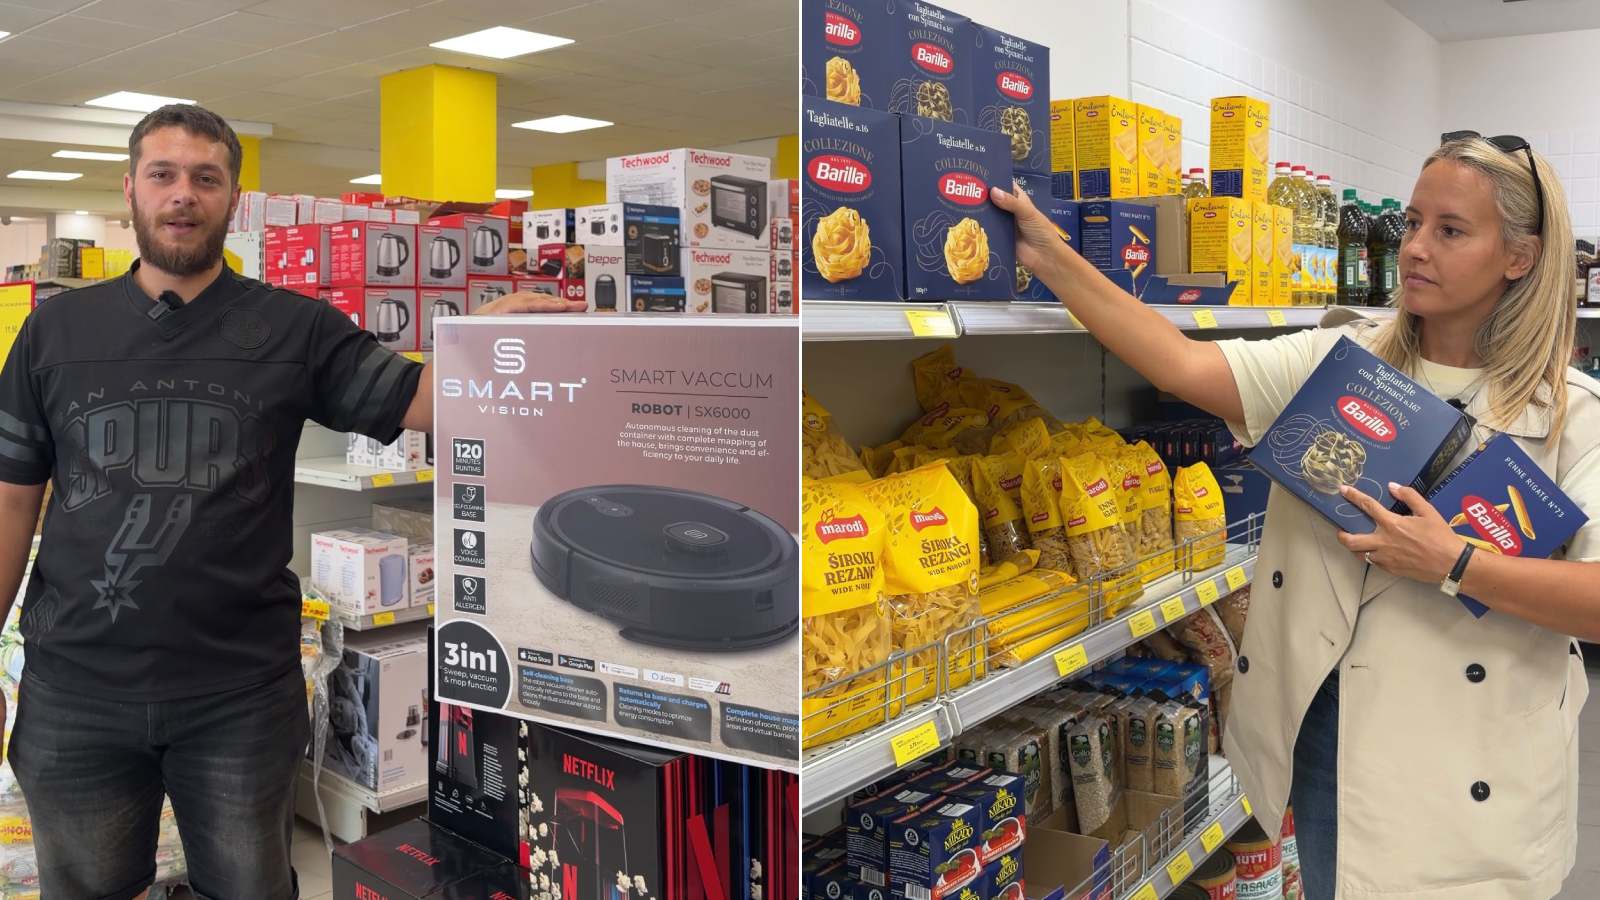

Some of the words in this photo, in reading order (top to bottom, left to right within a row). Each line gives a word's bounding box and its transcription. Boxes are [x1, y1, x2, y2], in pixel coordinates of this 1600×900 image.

[908, 12, 920, 23] con
[914, 2, 946, 21] Tagliatelle
[826, 22, 856, 41] arilla
[918, 48, 950, 68] Barilla
[1002, 76, 1029, 94] Barilla
[807, 110, 854, 130] Tagliatelle
[803, 136, 874, 164] COLLEZIONE
[936, 133, 974, 151] Tagliatelle
[621, 154, 670, 168] Techwood
[690, 152, 731, 166] Techwood
[935, 158, 990, 176] COLLEZIONE
[816, 162, 866, 185] Barilla
[945, 179, 982, 198] Barilla
[588, 254, 622, 266] beper
[692, 251, 731, 264] Techwood
[1126, 248, 1148, 260] Barilla
[610, 368, 676, 386] SMART
[680, 370, 774, 390] VACCUM
[1376, 364, 1416, 396] Tagliatelle
[130, 380, 264, 410] ANTONI
[442, 378, 583, 403] SMART
[1358, 368, 1374, 382] con
[1374, 377, 1406, 402] Spinaci
[1403, 399, 1422, 412] n.167
[478, 404, 543, 417] VISION
[631, 402, 683, 417] ROBOT
[694, 406, 751, 420] SX6000
[1346, 382, 1410, 429] COLLEZIONE
[1343, 401, 1389, 436] Barilla
[625, 422, 676, 432] Autonomous
[676, 424, 712, 436] cleaning
[713, 426, 724, 434] of
[724, 428, 738, 436] the
[740, 428, 759, 437] dust
[617, 440, 630, 448] the
[632, 440, 657, 450] house,
[658, 442, 684, 452] brings
[686, 446, 738, 456] convenience
[740, 448, 756, 456] and
[758, 448, 770, 458] ef-
[620, 432, 656, 440] container
[658, 433, 676, 441] with
[677, 434, 716, 446] complete
[718, 438, 756, 448] mapping
[758, 438, 768, 448] of
[454, 444, 482, 459] 120
[642, 450, 672, 460] ficiency
[674, 452, 684, 460] to
[684, 454, 702, 463] your
[704, 454, 724, 465] daily
[726, 456, 741, 465] life.
[1505, 456, 1526, 480] PENNE
[1526, 478, 1550, 503] RIGATE
[821, 520, 864, 535] marodi
[1466, 502, 1515, 550] Barilla
[461, 548, 478, 556] VOICE
[920, 536, 960, 554] ŠIROKI
[828, 552, 874, 569] ŠIROKI
[919, 543, 970, 568] REZANCI
[928, 567, 945, 576] WIDE
[464, 594, 476, 602] ANTI
[831, 586, 854, 595] WIDE
[456, 602, 484, 611] ALLERGEN
[444, 642, 498, 674] 3in1
[444, 666, 468, 681] Sweep,
[469, 672, 498, 685] vaccum
[450, 678, 466, 688] mop
[467, 679, 498, 692] function
[682, 698, 708, 710] charges
[726, 706, 758, 718] Complete
[760, 712, 781, 721] house
[726, 715, 754, 726] Definition
[458, 731, 468, 756] N
[563, 753, 614, 792] NETFLIX
[989, 796, 1016, 818] MIKADO
[944, 826, 974, 850] MIKADO
[398, 843, 440, 866] NETFLIX
[996, 859, 1018, 885] MIKADO
